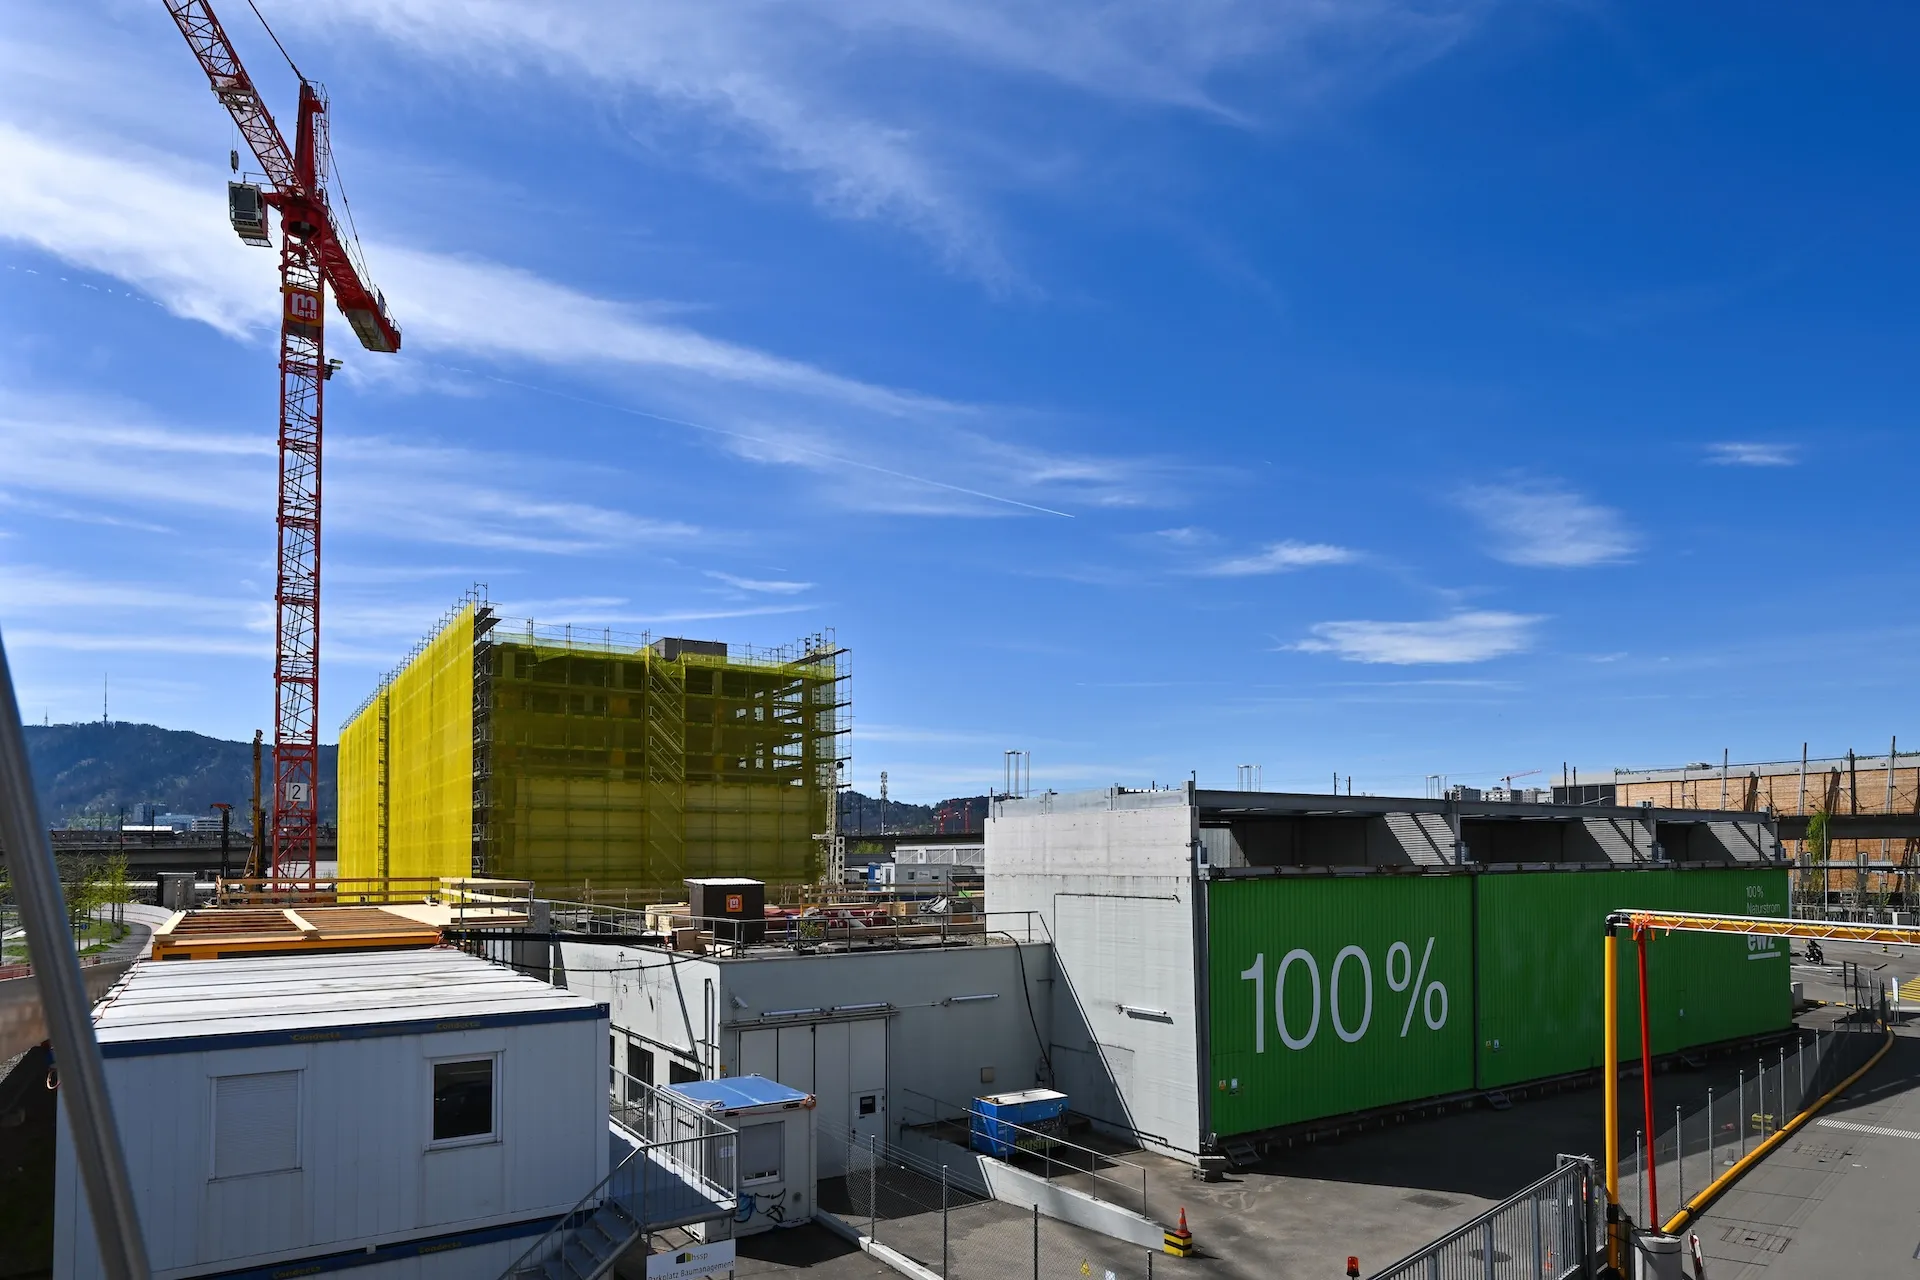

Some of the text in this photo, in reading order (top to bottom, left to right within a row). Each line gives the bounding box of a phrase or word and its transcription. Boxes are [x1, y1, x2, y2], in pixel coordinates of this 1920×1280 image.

[292, 785, 301, 800] 2
[1747, 902, 1781, 915] Naturstrom
[1241, 937, 1448, 1054] 100%
[681, 1260, 734, 1277] Baumanagement
